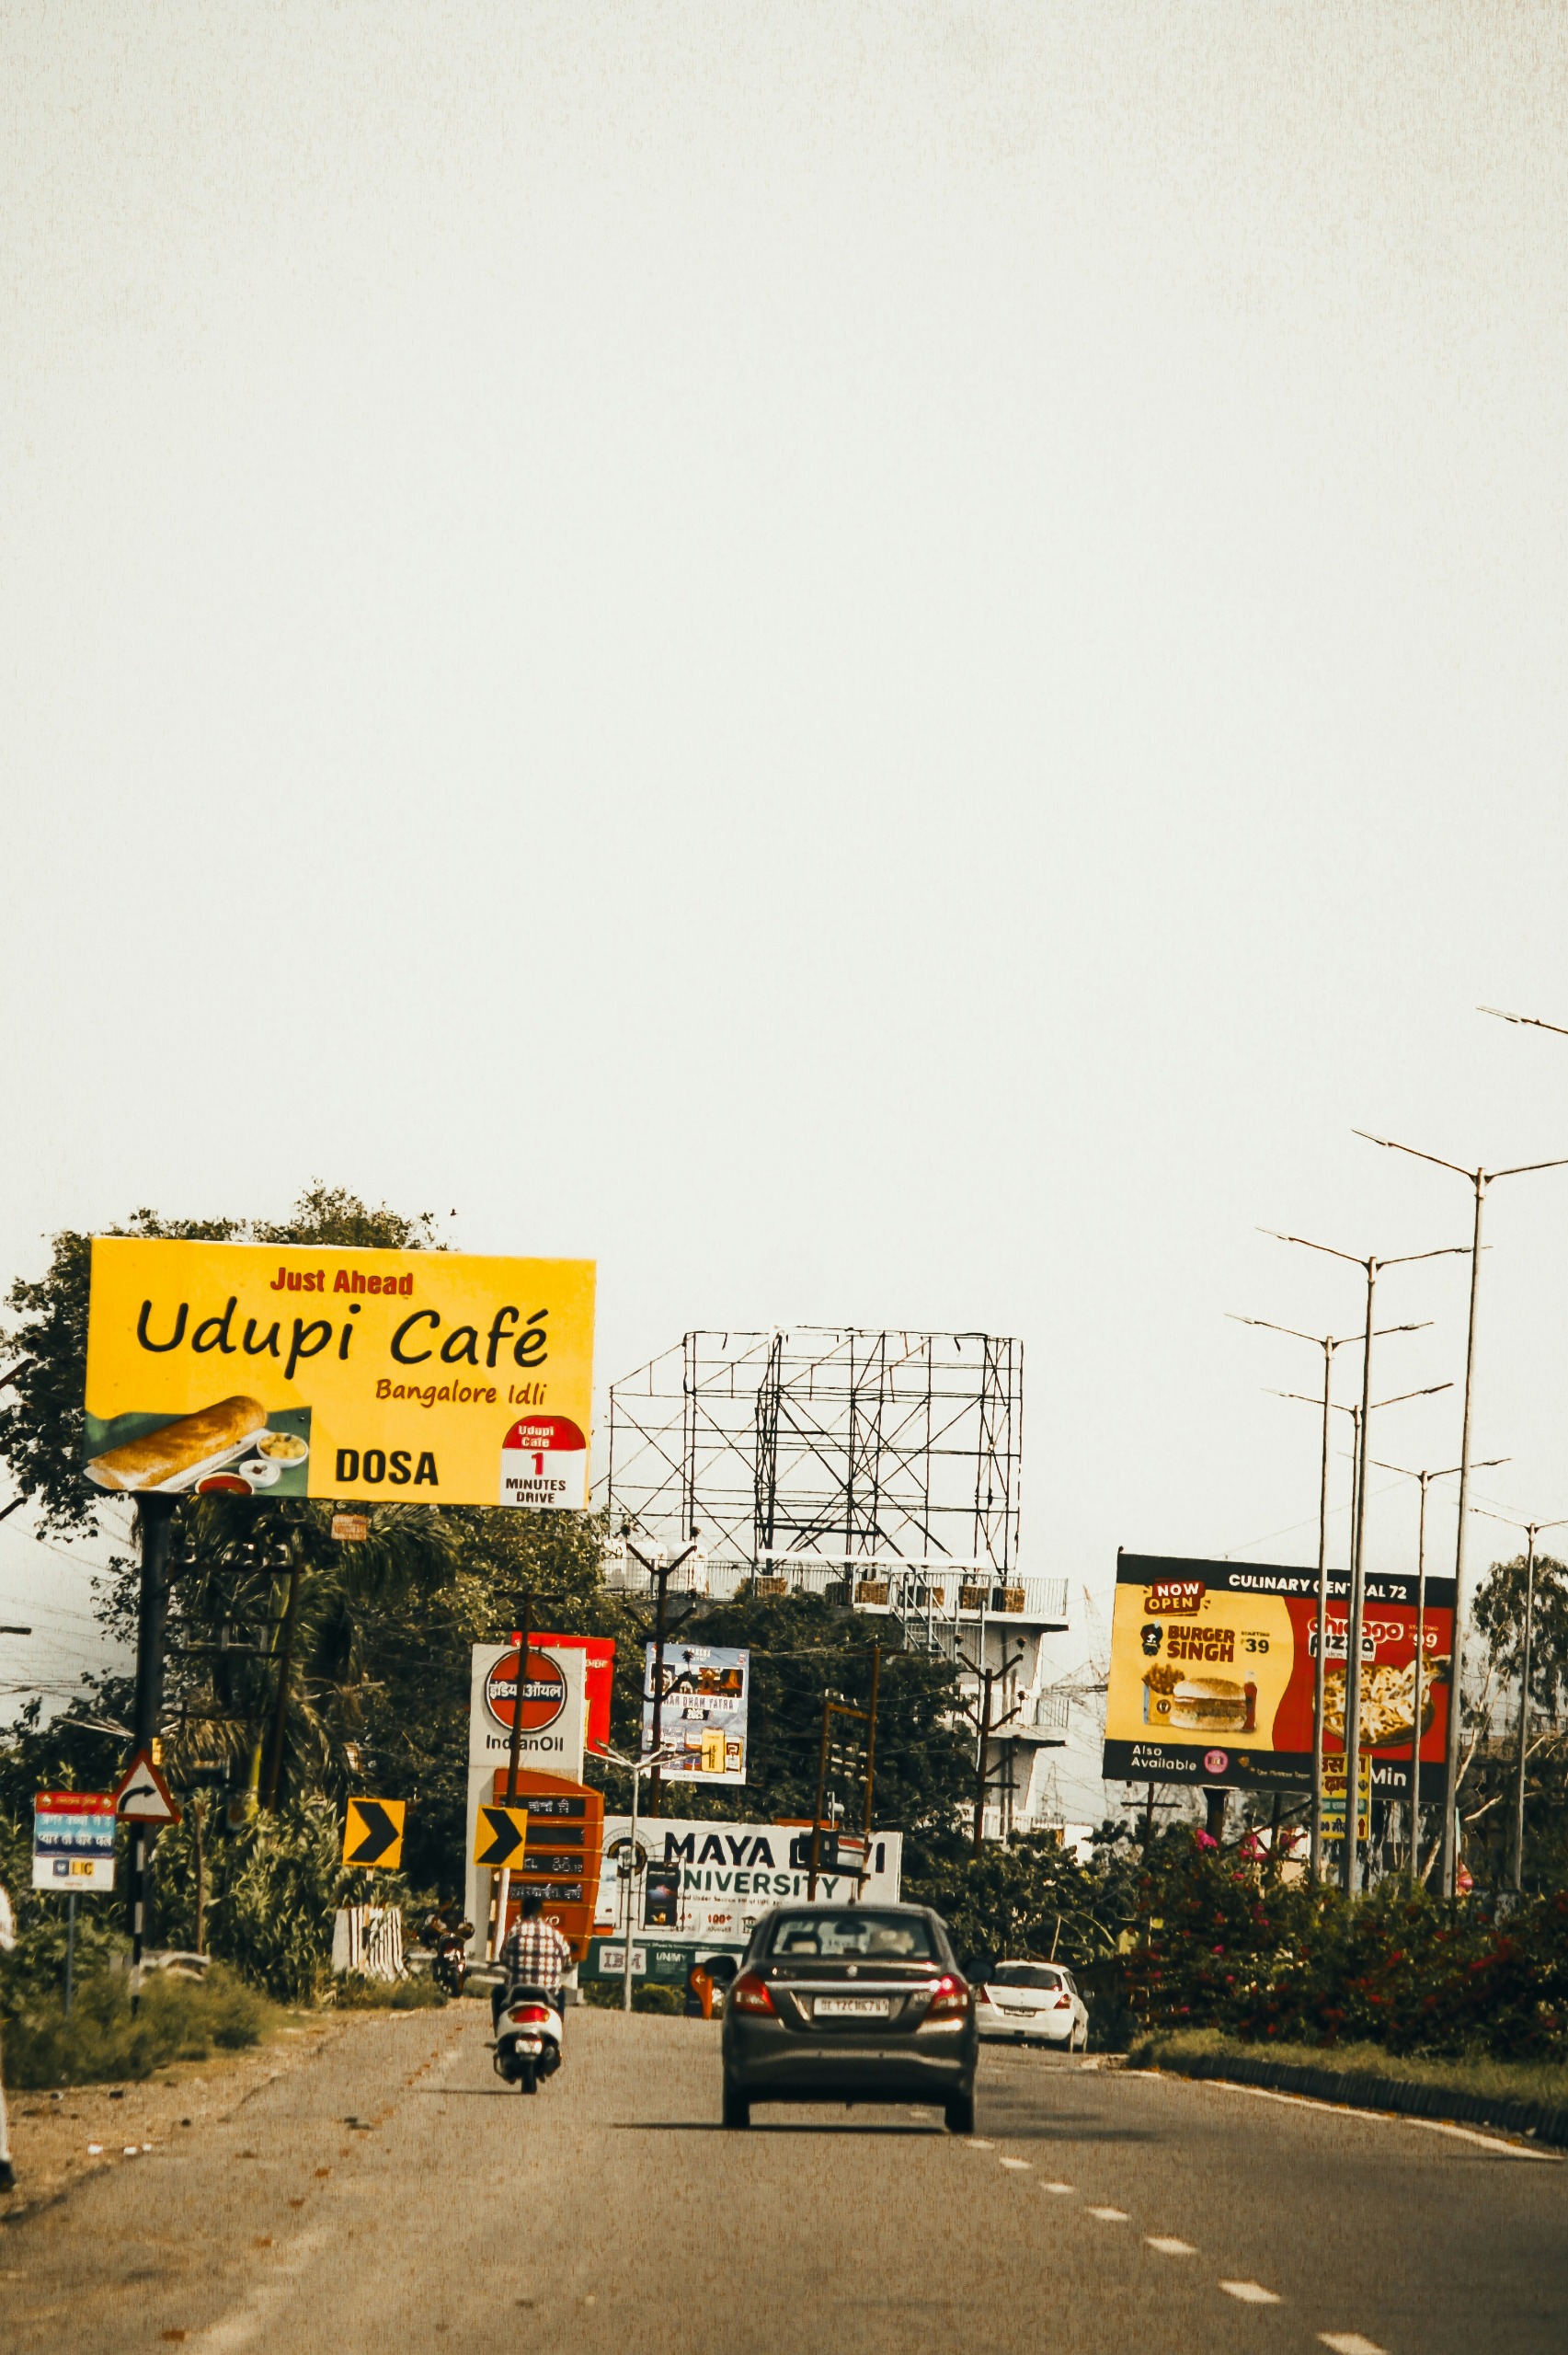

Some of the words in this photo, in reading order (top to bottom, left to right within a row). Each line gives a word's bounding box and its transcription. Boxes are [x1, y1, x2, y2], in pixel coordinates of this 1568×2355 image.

[270, 1267, 326, 1292] Just
[333, 1269, 414, 1296] Ahead
[137, 1295, 361, 1381] Udupi
[389, 1305, 550, 1368] Café
[375, 1377, 498, 1407] Bangalore
[509, 1384, 548, 1406] Idli
[518, 1425, 555, 1437] Udupi
[521, 1436, 551, 1449] Cafe
[336, 1448, 440, 1487] DOSA
[531, 1452, 544, 1476] 1
[505, 1477, 567, 1491] MINUTES
[516, 1491, 555, 1504] DRIVE
[1156, 1580, 1199, 1597] NOW
[1228, 1572, 1310, 1594] CULINARY
[1312, 1581, 1386, 1598] CENAL
[1389, 1584, 1407, 1600] 72
[1148, 1596, 1194, 1611] OPEN
[1166, 1625, 1236, 1645] BURGER
[1166, 1640, 1235, 1663] SINGH
[486, 1734, 564, 1752] IndanOil
[1132, 1744, 1162, 1756] Also
[1131, 1756, 1197, 1772] Available
[664, 1831, 777, 1869] MAYA
[72, 1861, 94, 1877] LIC
